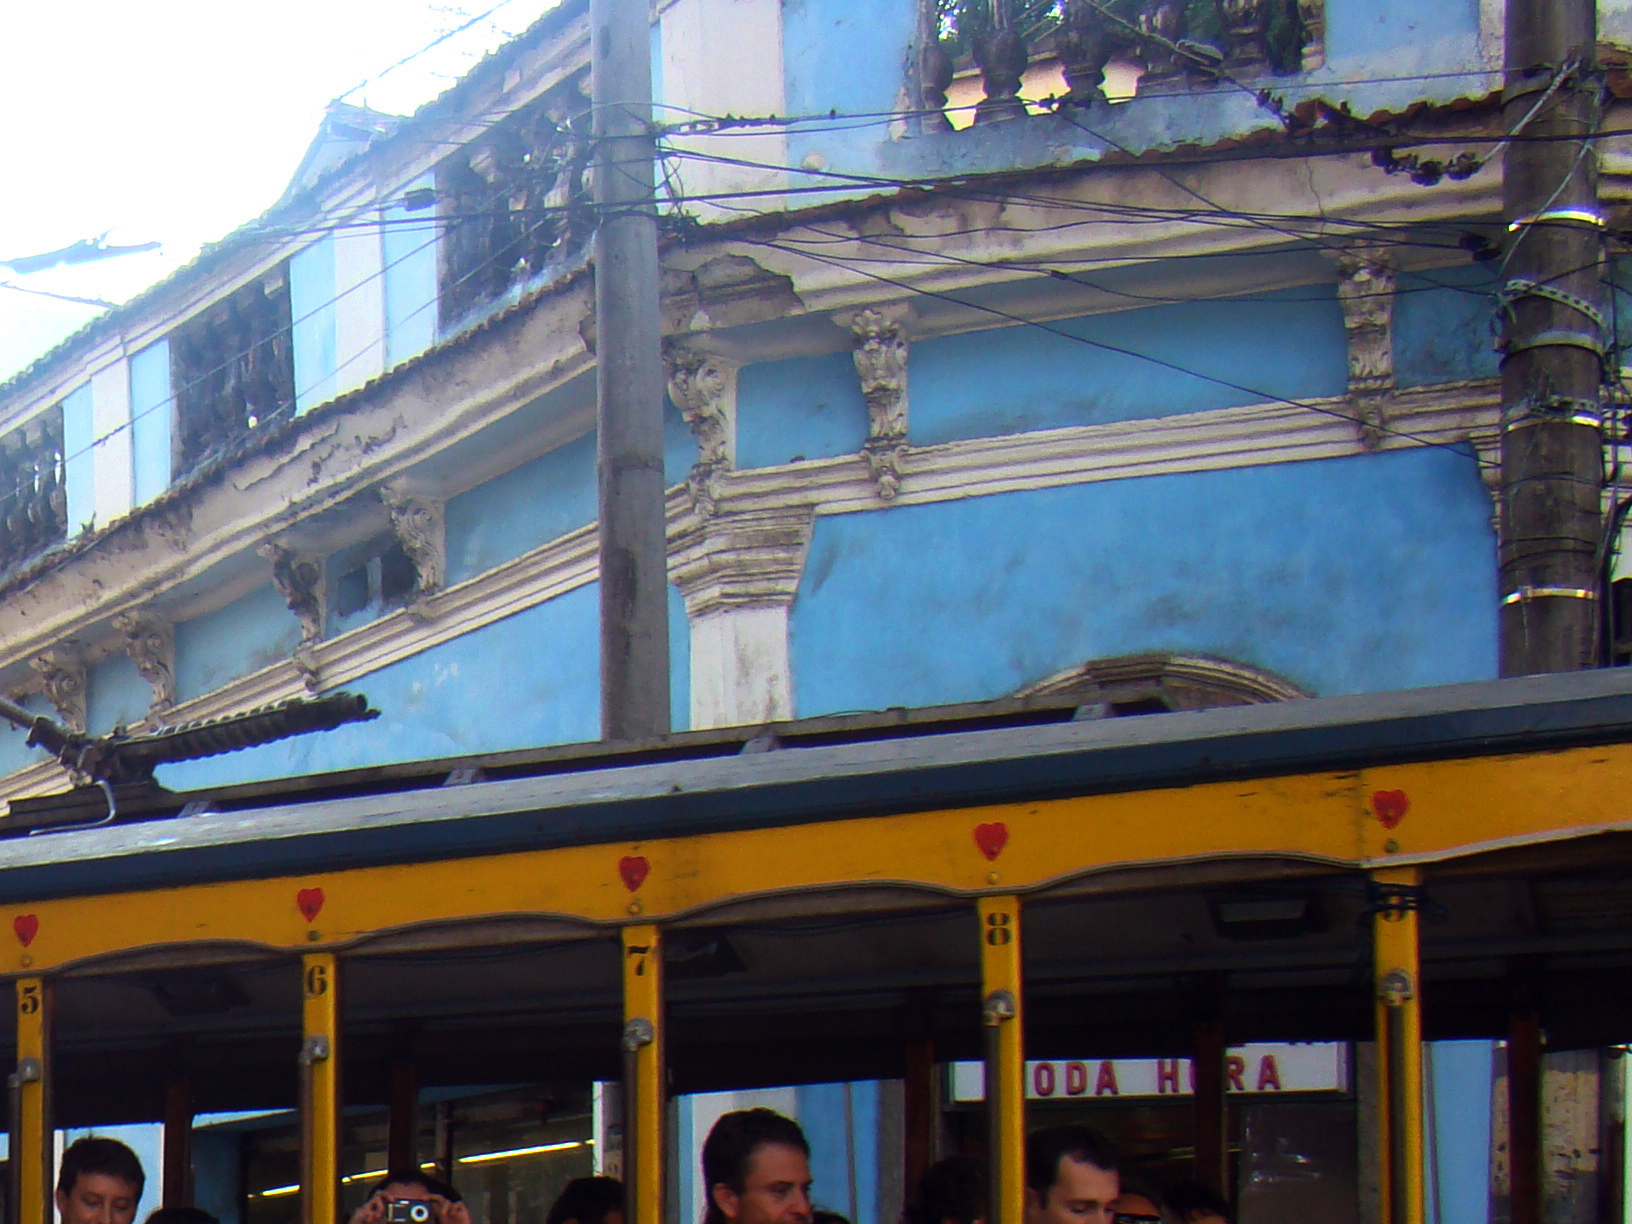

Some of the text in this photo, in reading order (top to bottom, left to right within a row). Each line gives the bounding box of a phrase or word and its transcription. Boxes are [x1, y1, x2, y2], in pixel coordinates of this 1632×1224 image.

[986, 911, 1012, 947] 8
[627, 944, 650, 977] 7
[306, 964, 328, 996] 6
[20, 984, 39, 1015] 5
[1032, 1054, 1282, 1097] ODA HRA
